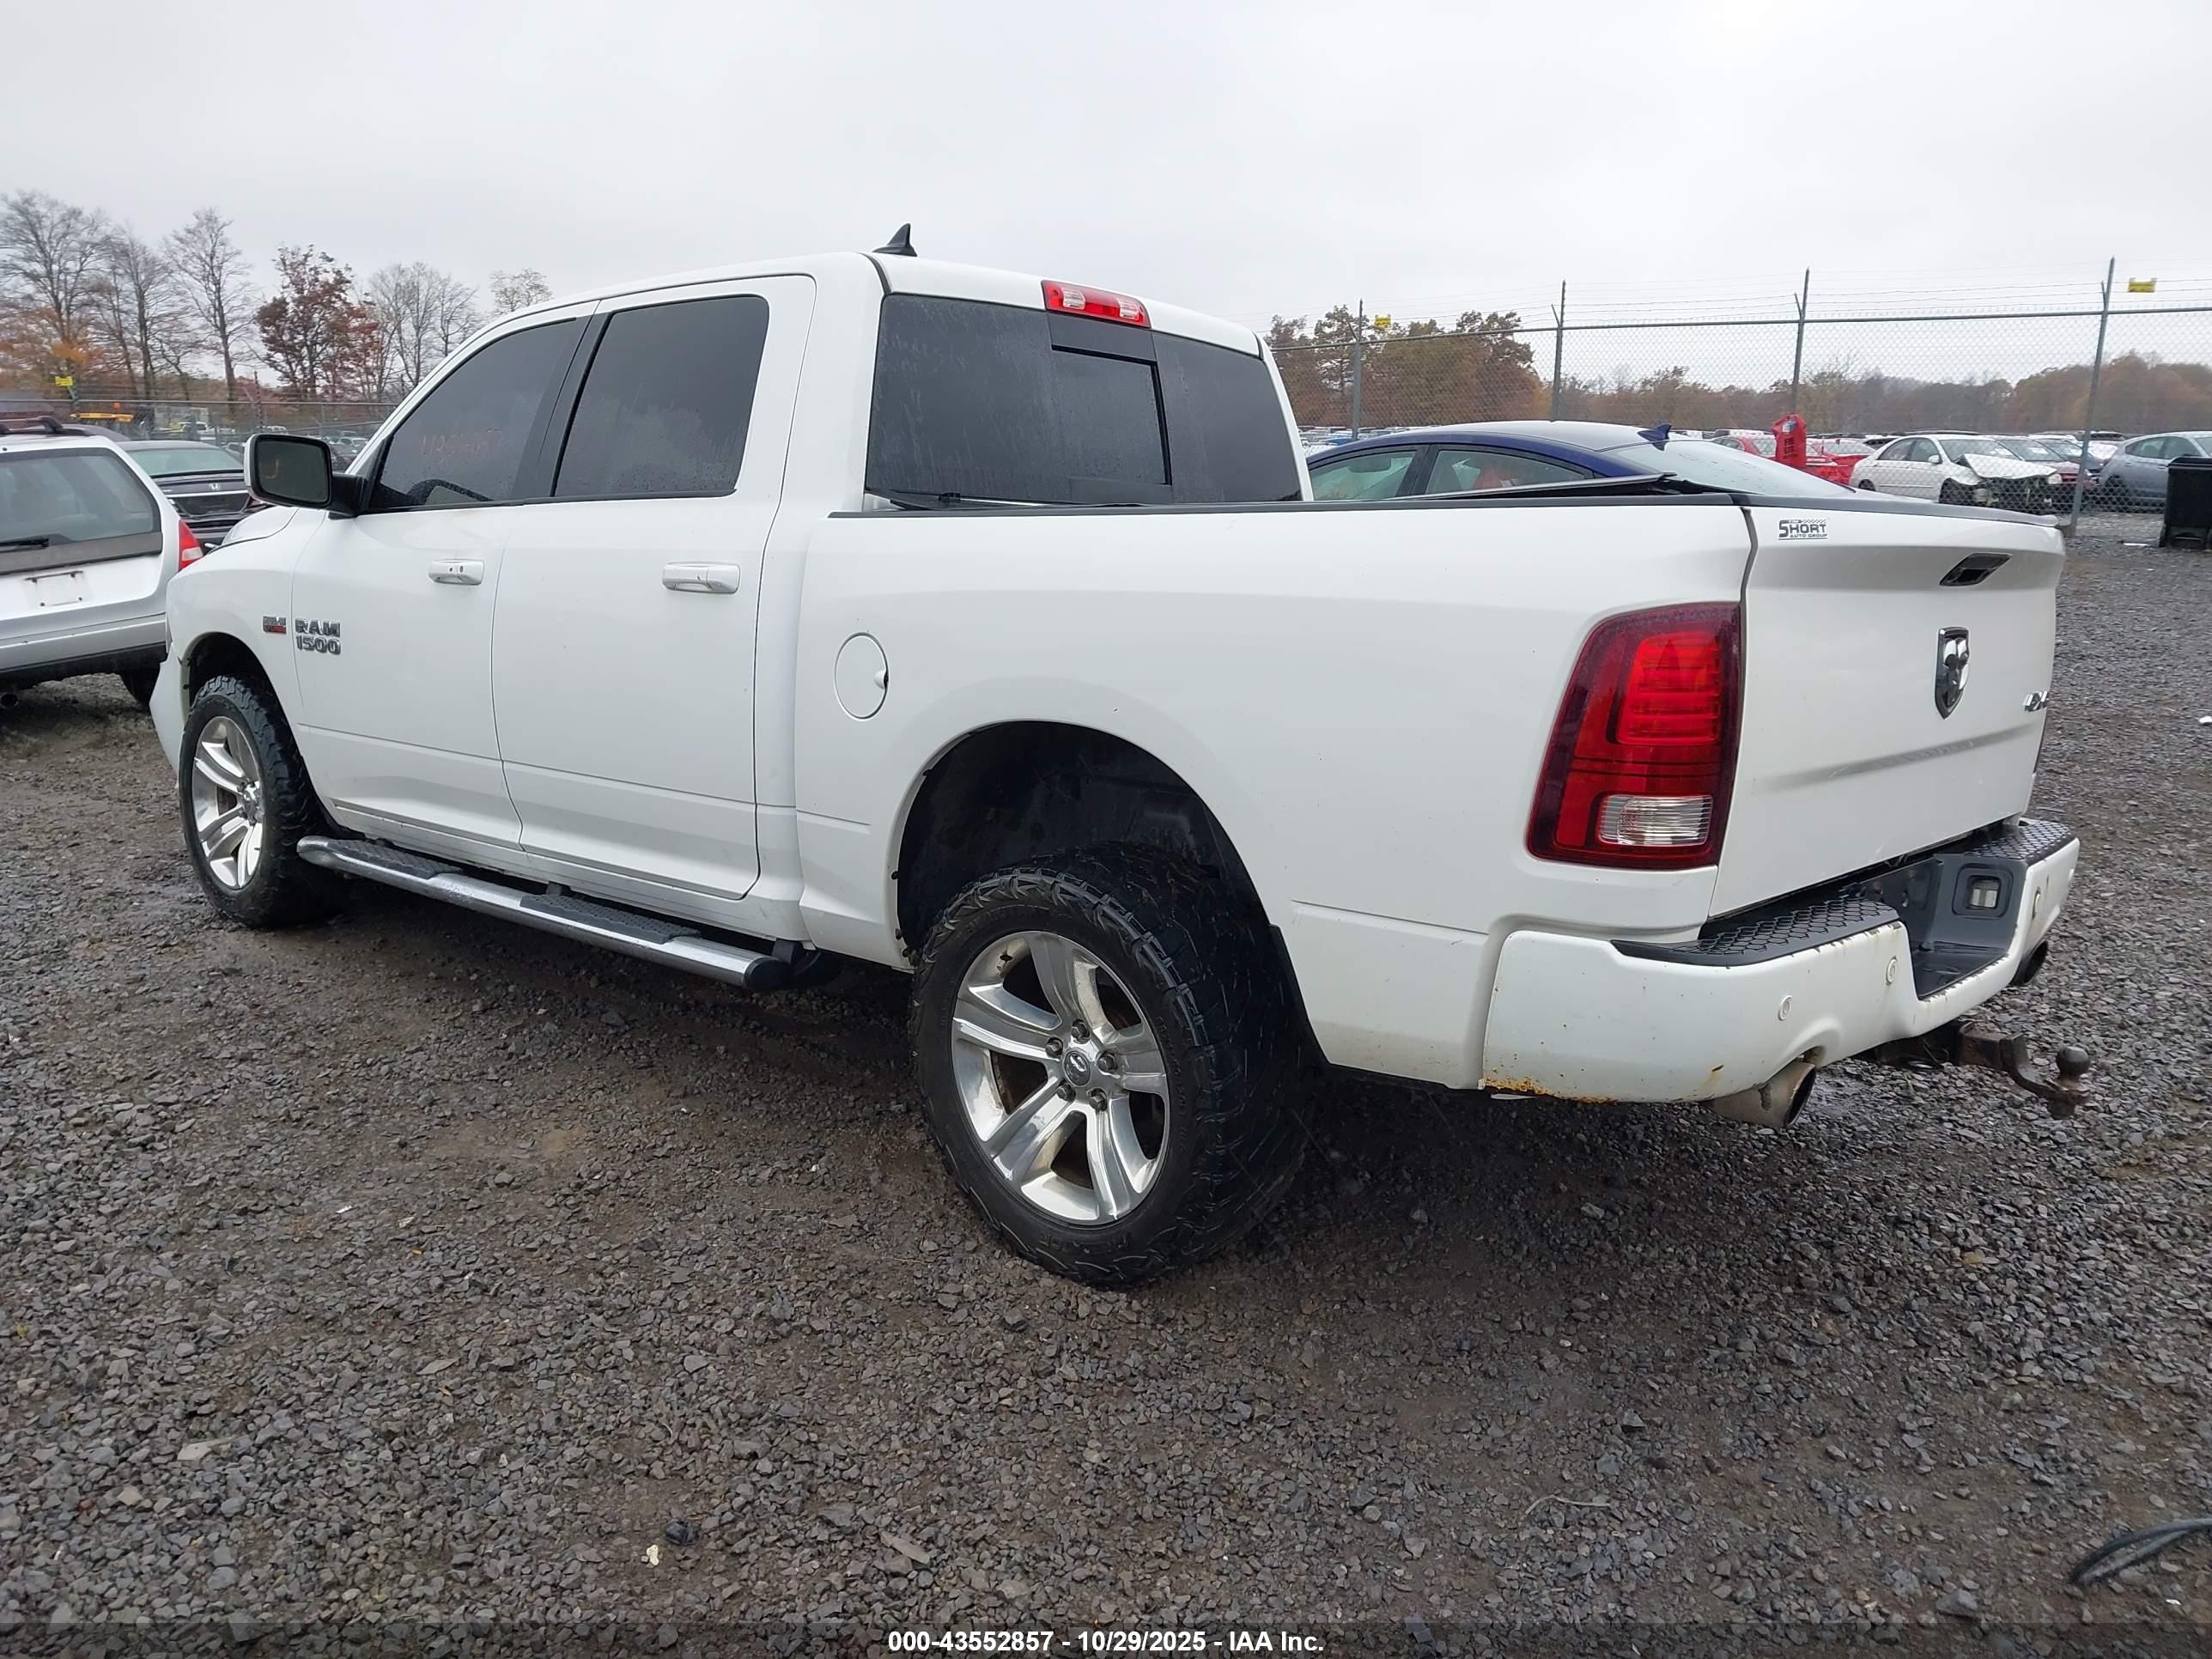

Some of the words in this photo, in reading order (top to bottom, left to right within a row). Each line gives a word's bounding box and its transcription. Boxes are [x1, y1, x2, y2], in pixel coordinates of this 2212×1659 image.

[1779, 519, 1826, 538] SHORT
[295, 617, 341, 637] RAM
[295, 635, 342, 655] 1500
